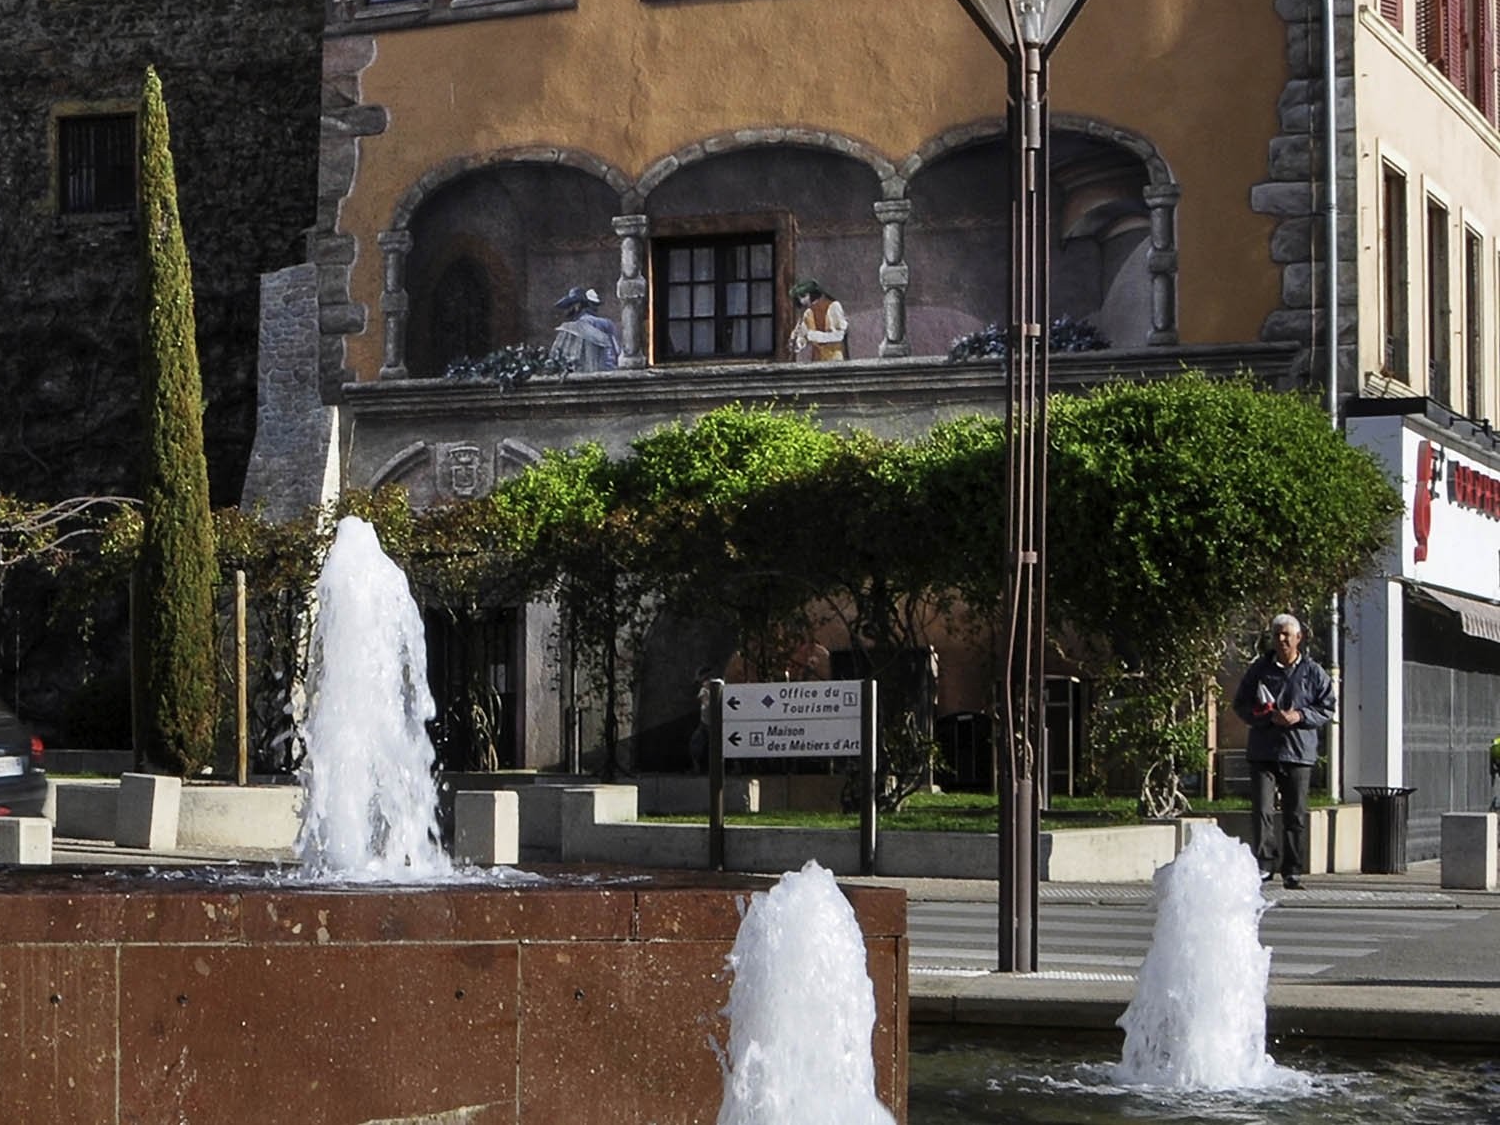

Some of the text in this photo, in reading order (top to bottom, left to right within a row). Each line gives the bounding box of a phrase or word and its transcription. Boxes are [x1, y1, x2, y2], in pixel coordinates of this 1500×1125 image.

[779, 686, 840, 699] Office du
[782, 702, 840, 714] Tourisme
[766, 725, 805, 736] Maison
[767, 740, 787, 751] des
[832, 738, 860, 750] d'Art
